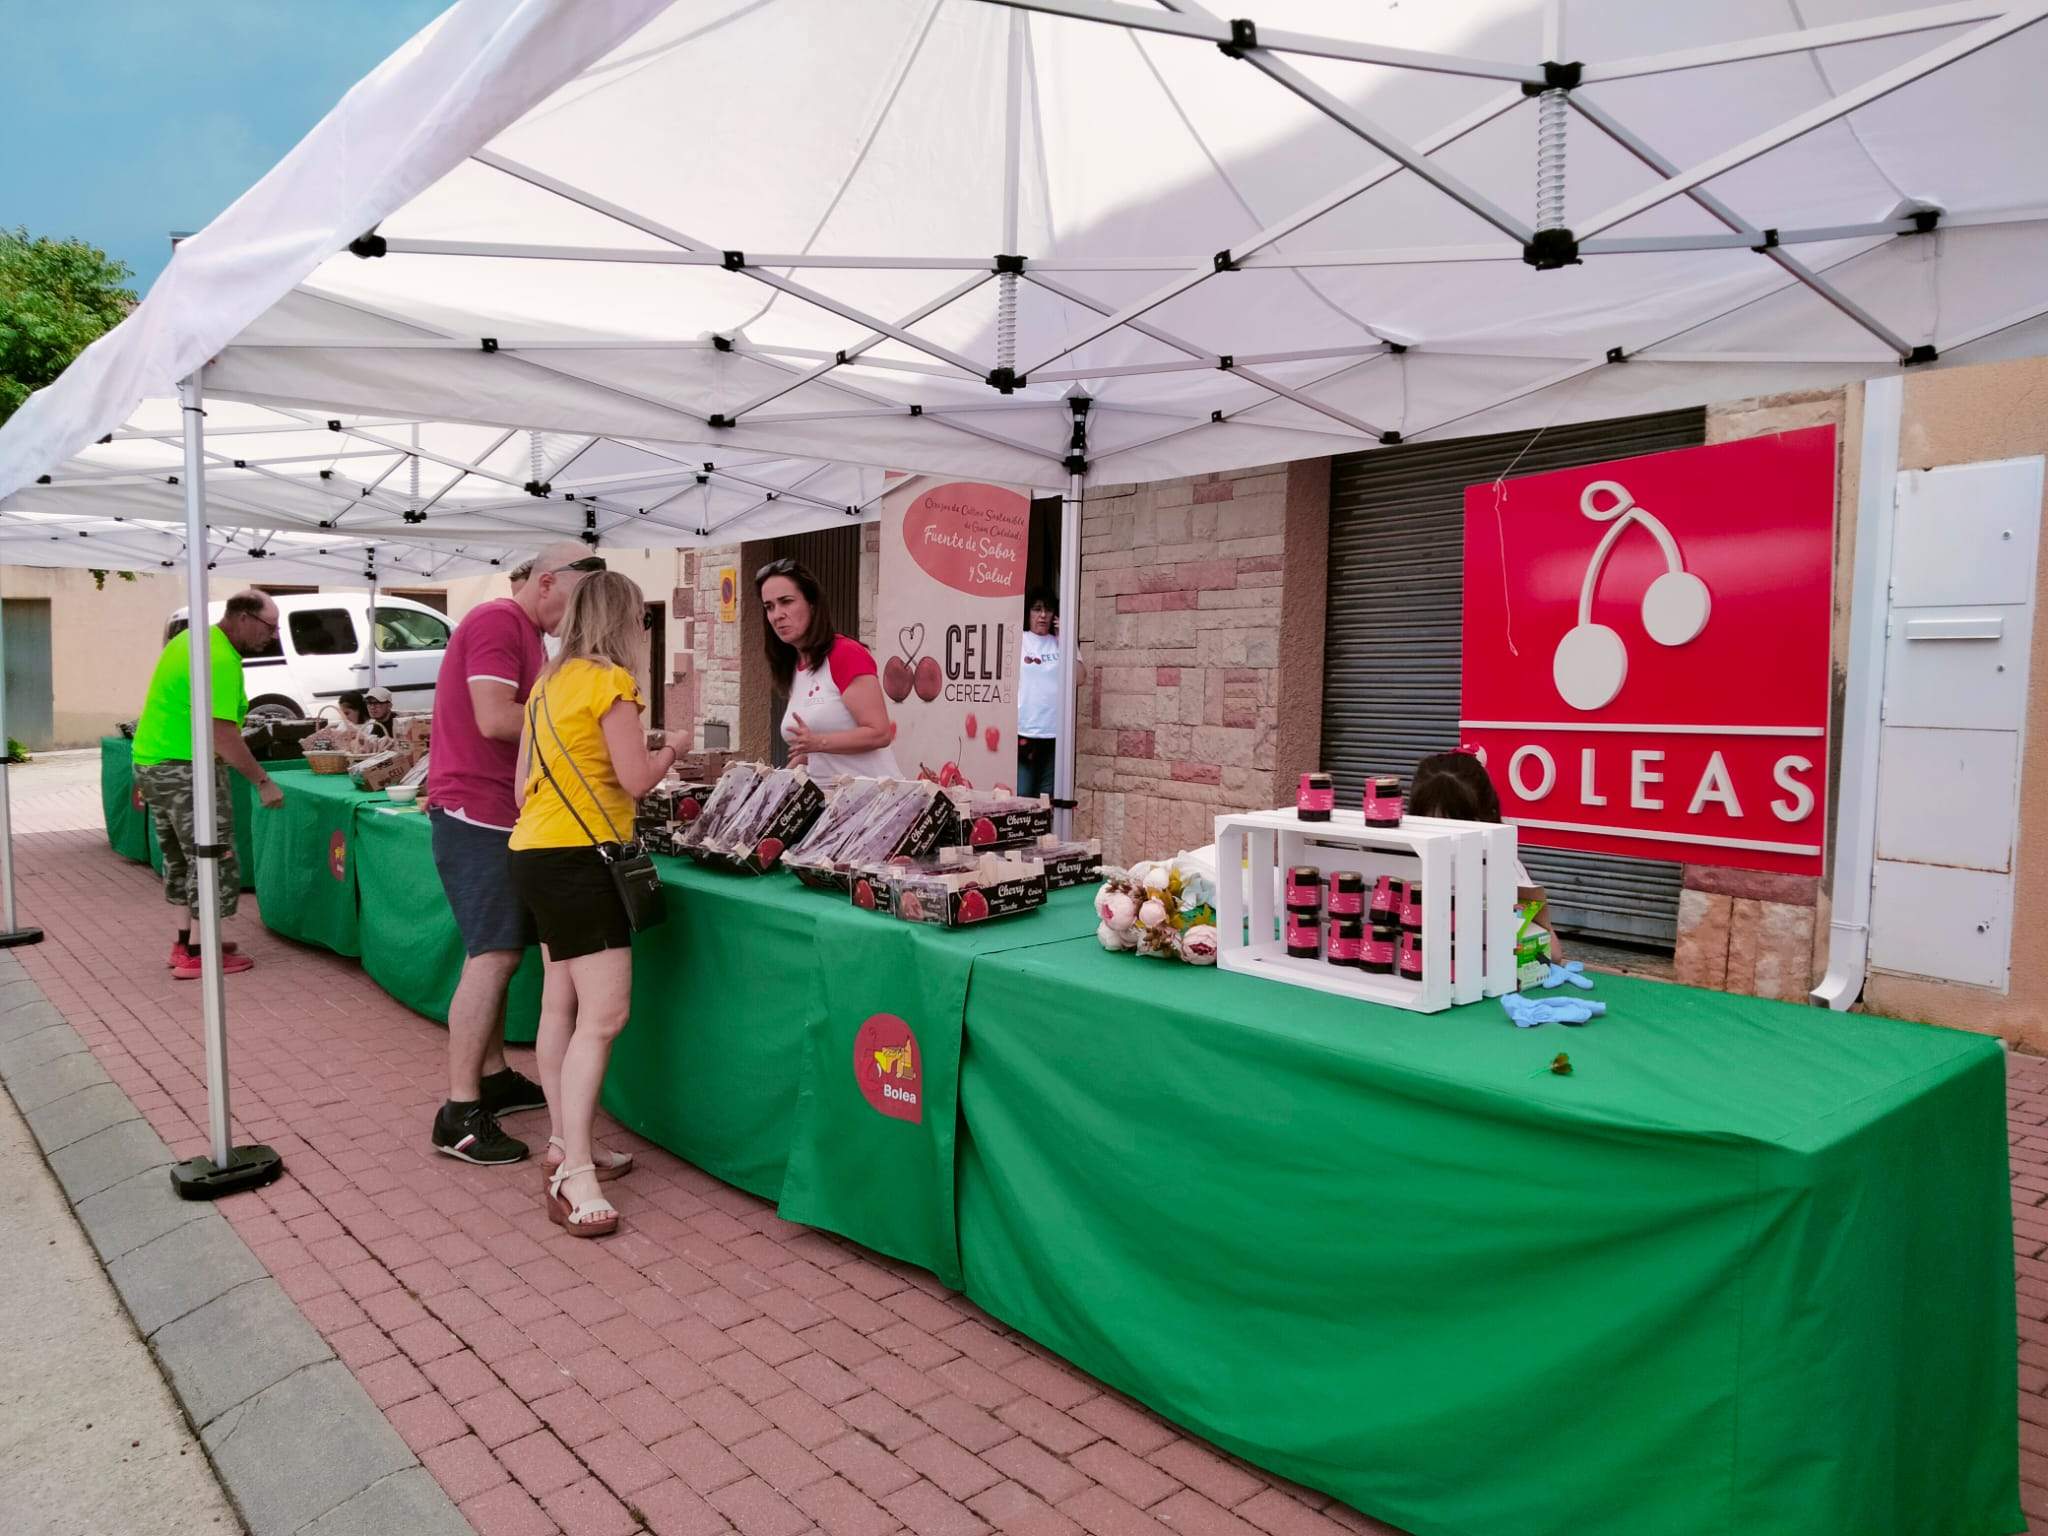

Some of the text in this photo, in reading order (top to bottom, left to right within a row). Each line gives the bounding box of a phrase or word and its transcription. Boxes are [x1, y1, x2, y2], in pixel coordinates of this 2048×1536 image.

[924, 525, 1016, 562] Fuente de Sabor
[969, 562, 1013, 586] y Salud
[945, 624, 1004, 680] CELI
[944, 683, 1002, 703] CEREZA
[1464, 744, 1815, 822] OLEAS
[911, 814, 933, 843] Cherry
[1006, 814, 1032, 826] Cherry
[1057, 861, 1081, 874] Cherry
[998, 884, 1025, 897] Cherry
[883, 1083, 917, 1104] Bolea
